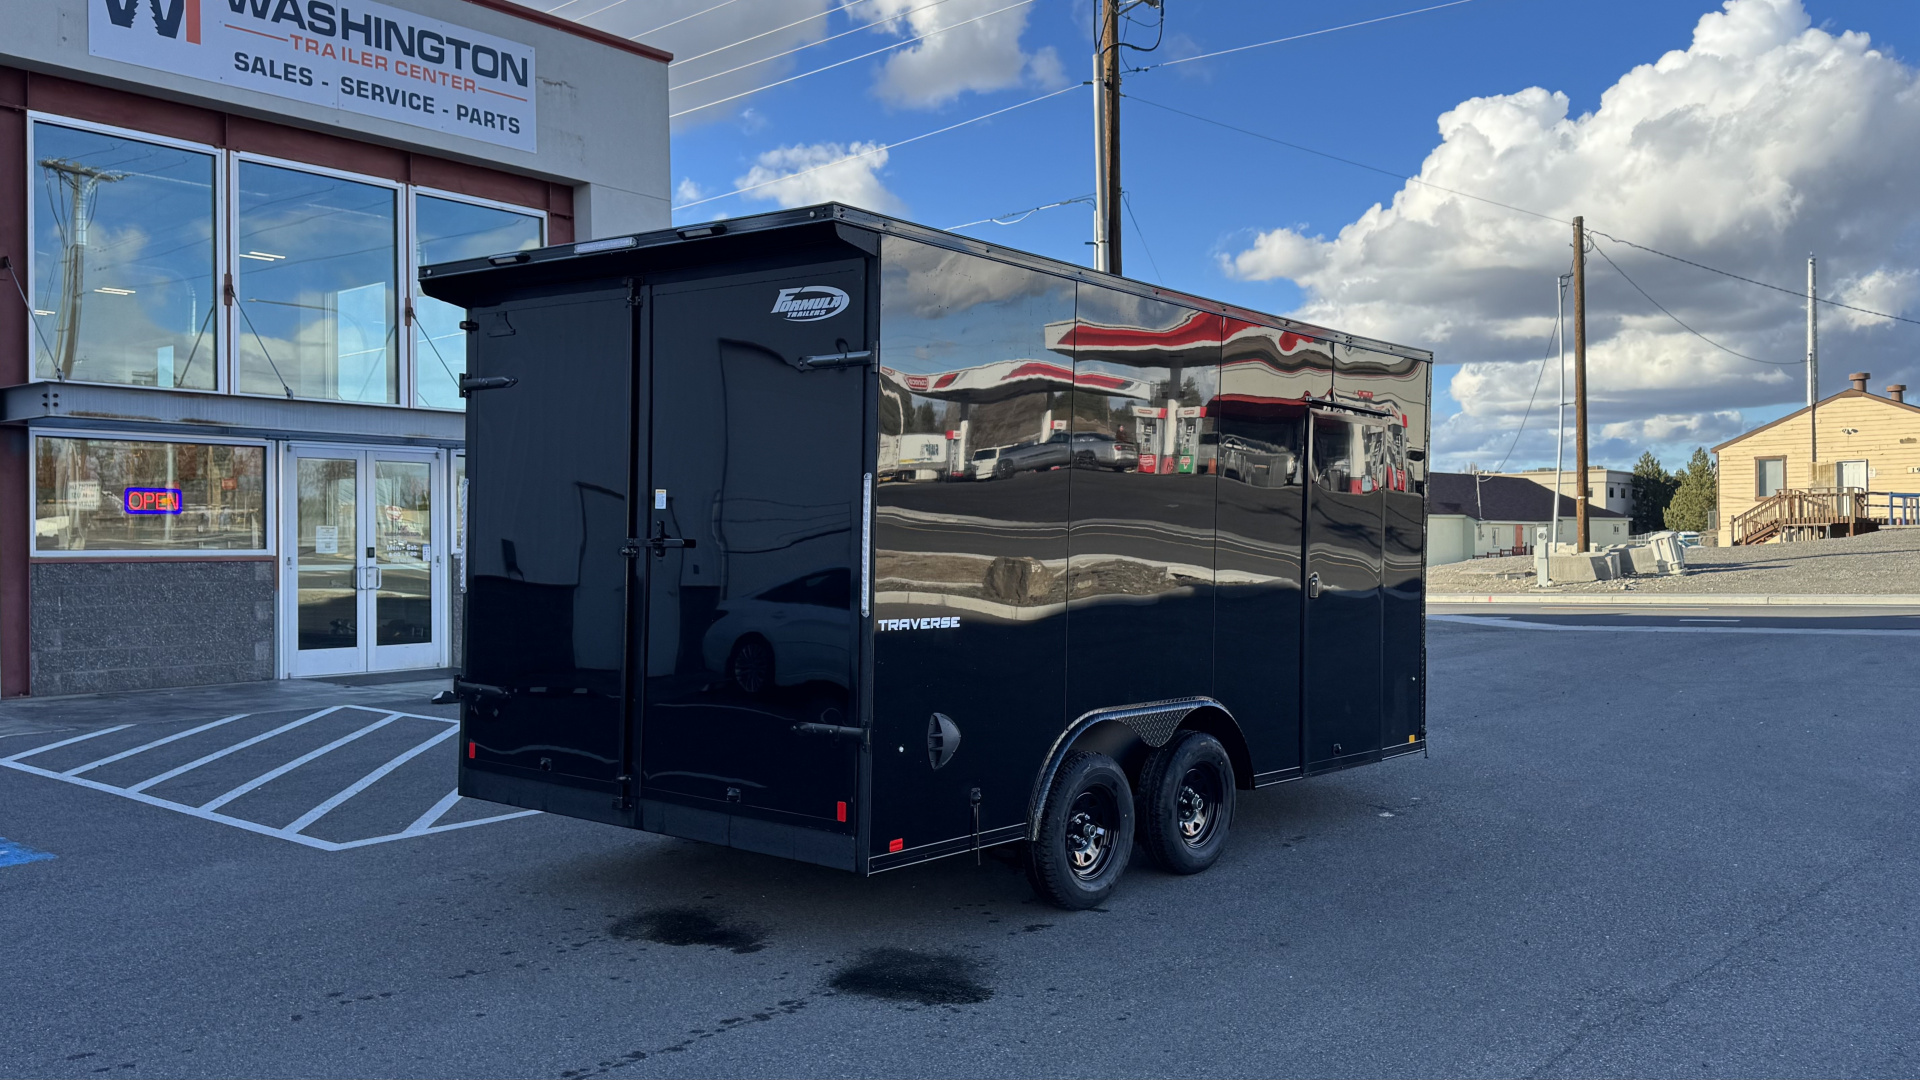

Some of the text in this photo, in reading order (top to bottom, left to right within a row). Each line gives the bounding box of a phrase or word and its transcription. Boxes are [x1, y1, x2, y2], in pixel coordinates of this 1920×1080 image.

[289, 33, 476, 93] TRAILER CENTER
[234, 52, 313, 87] SALES
[340, 76, 435, 114] SERVICE
[456, 104, 521, 134] PARTS
[770, 286, 843, 313] FORMULA
[787, 309, 827, 318] TRAILERS
[128, 491, 179, 510] OPEN
[877, 616, 961, 632] TRAVERSE
